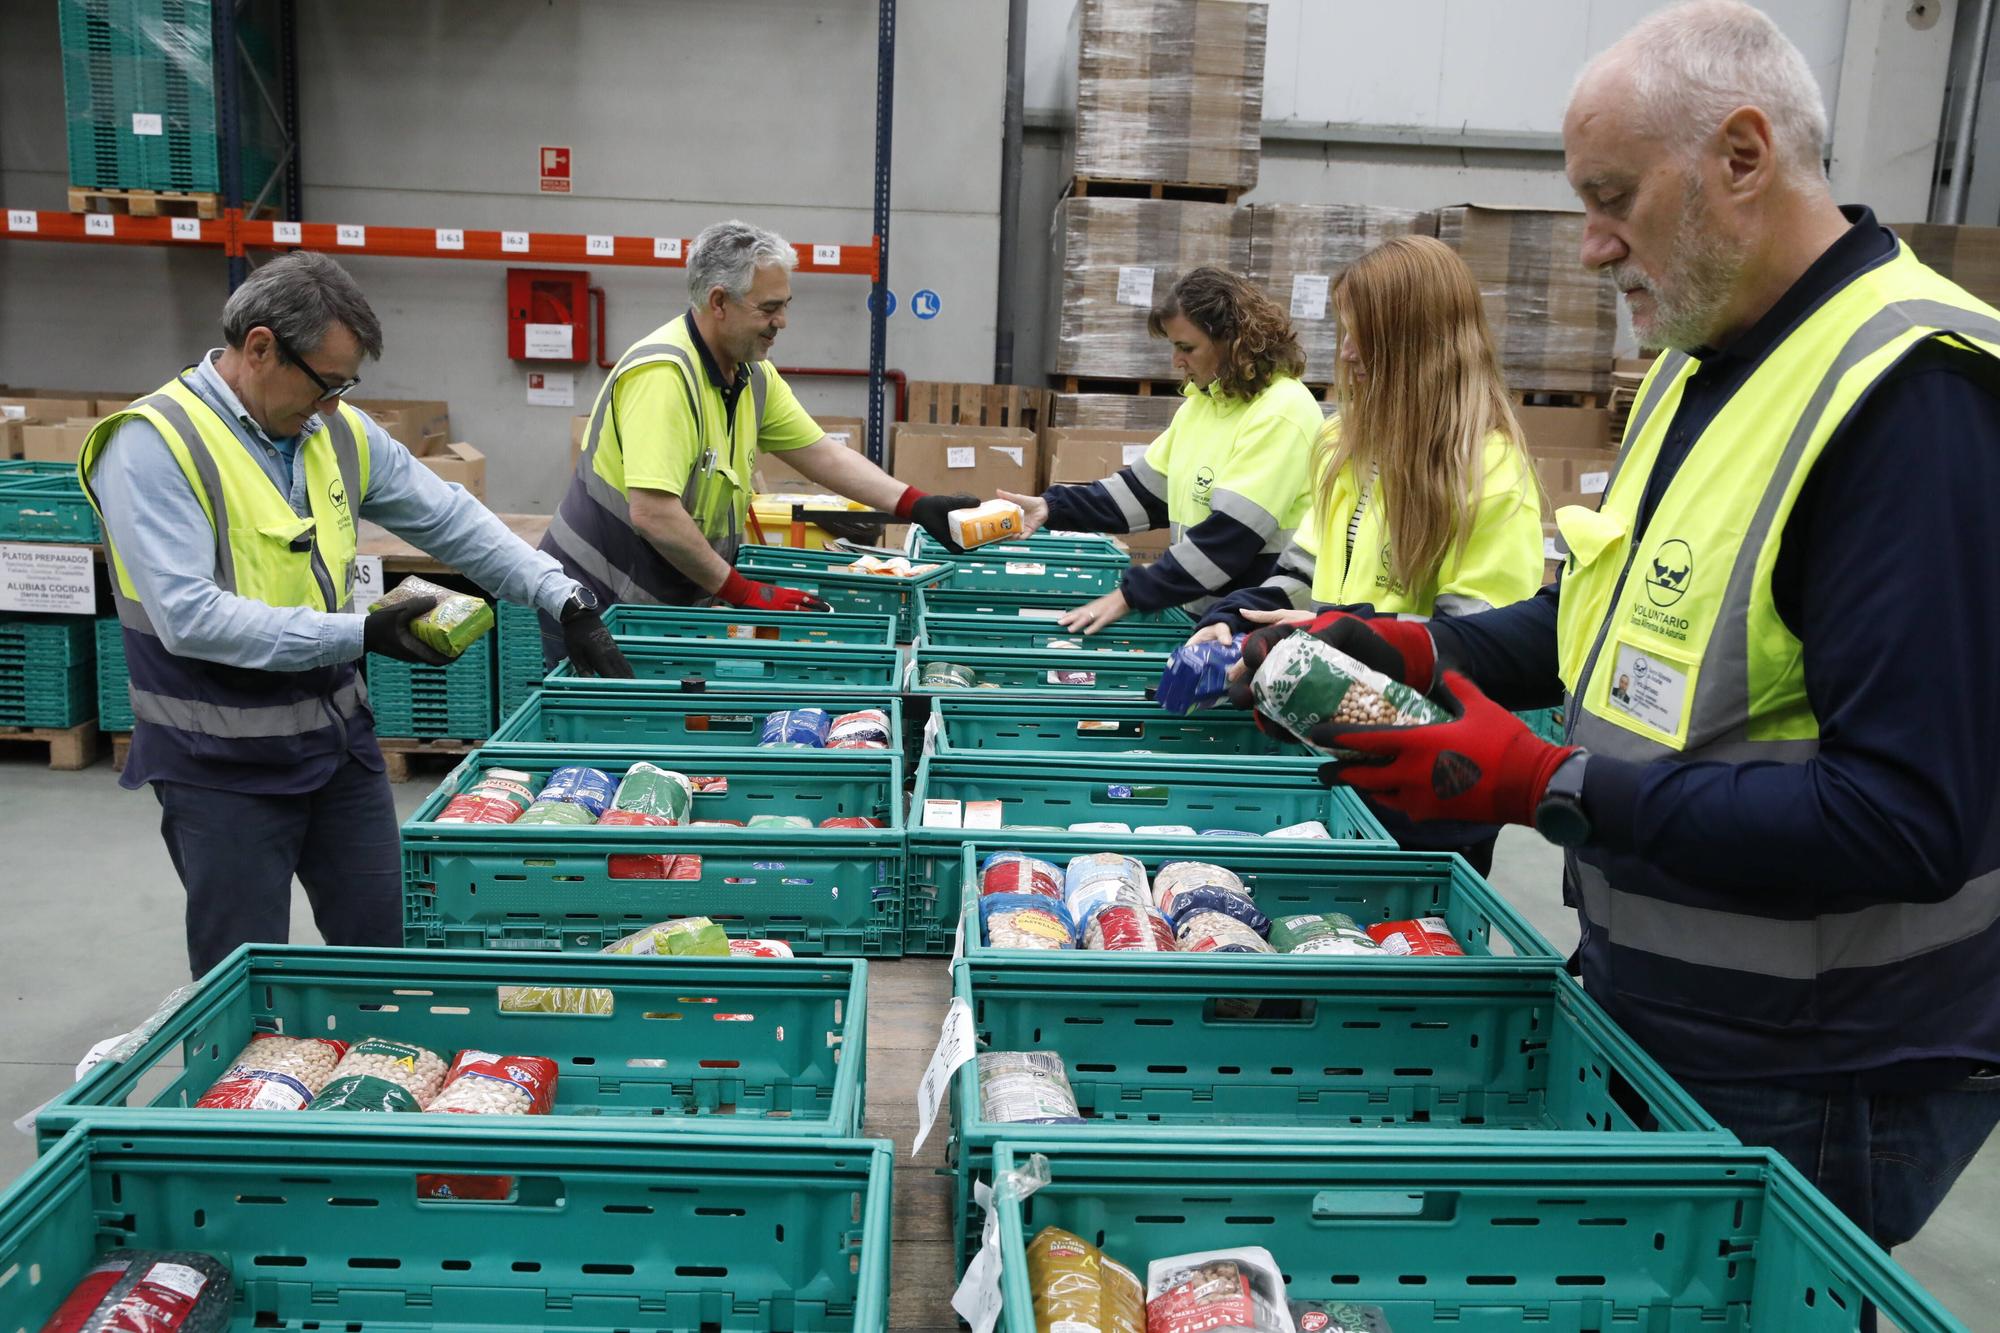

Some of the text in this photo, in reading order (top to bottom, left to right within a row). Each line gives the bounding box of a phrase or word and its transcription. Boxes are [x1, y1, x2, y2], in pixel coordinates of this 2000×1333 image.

[2, 551, 89, 564] PLATOS PREPARADOS
[7, 582, 90, 593] ALUBIAS COCIDAS
[1634, 602, 1689, 630] VOLUNTARIO
